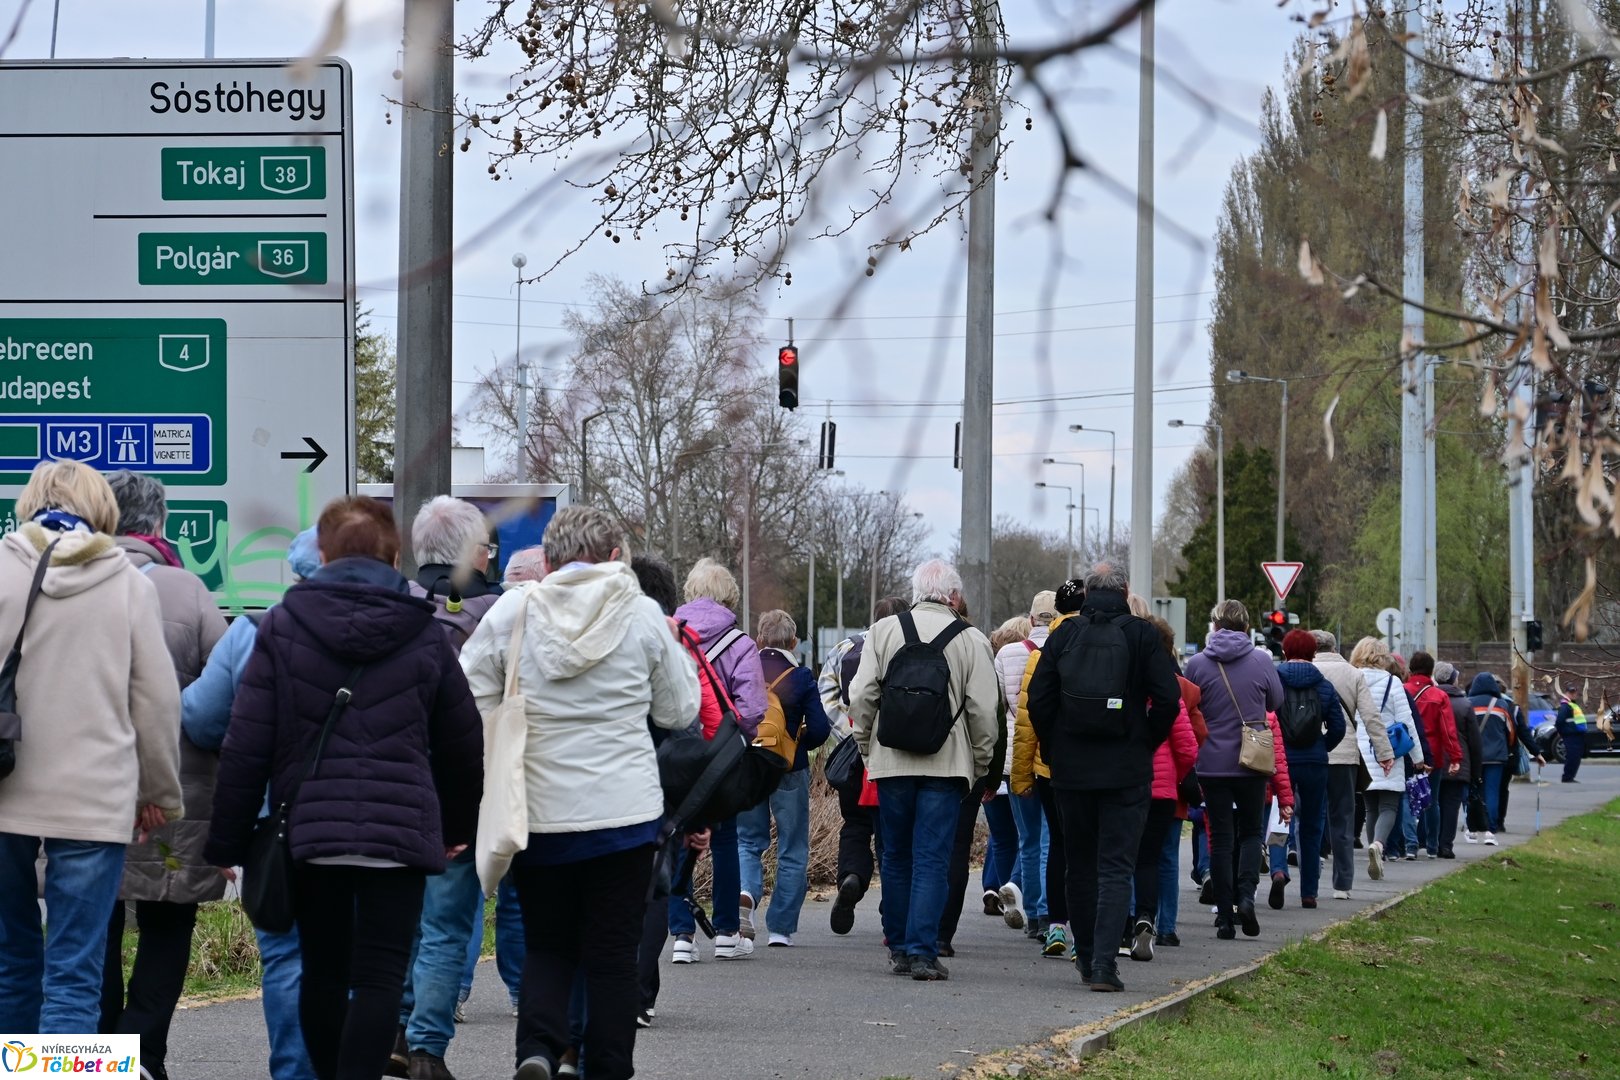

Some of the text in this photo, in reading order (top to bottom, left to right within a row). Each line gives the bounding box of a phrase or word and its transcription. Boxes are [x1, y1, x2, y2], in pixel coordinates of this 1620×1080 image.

[150, 81, 325, 120] Sóstóhegy
[177, 161, 244, 190] Tokaj
[276, 167, 295, 183] 38
[157, 245, 240, 275] Polgár
[273, 249, 293, 265] 36
[180, 344, 189, 360] 4
[58, 431, 91, 452] M3
[154, 430, 191, 438] MATRICA
[155, 451, 190, 459] VIGNETTE
[179, 519, 197, 537] 41
